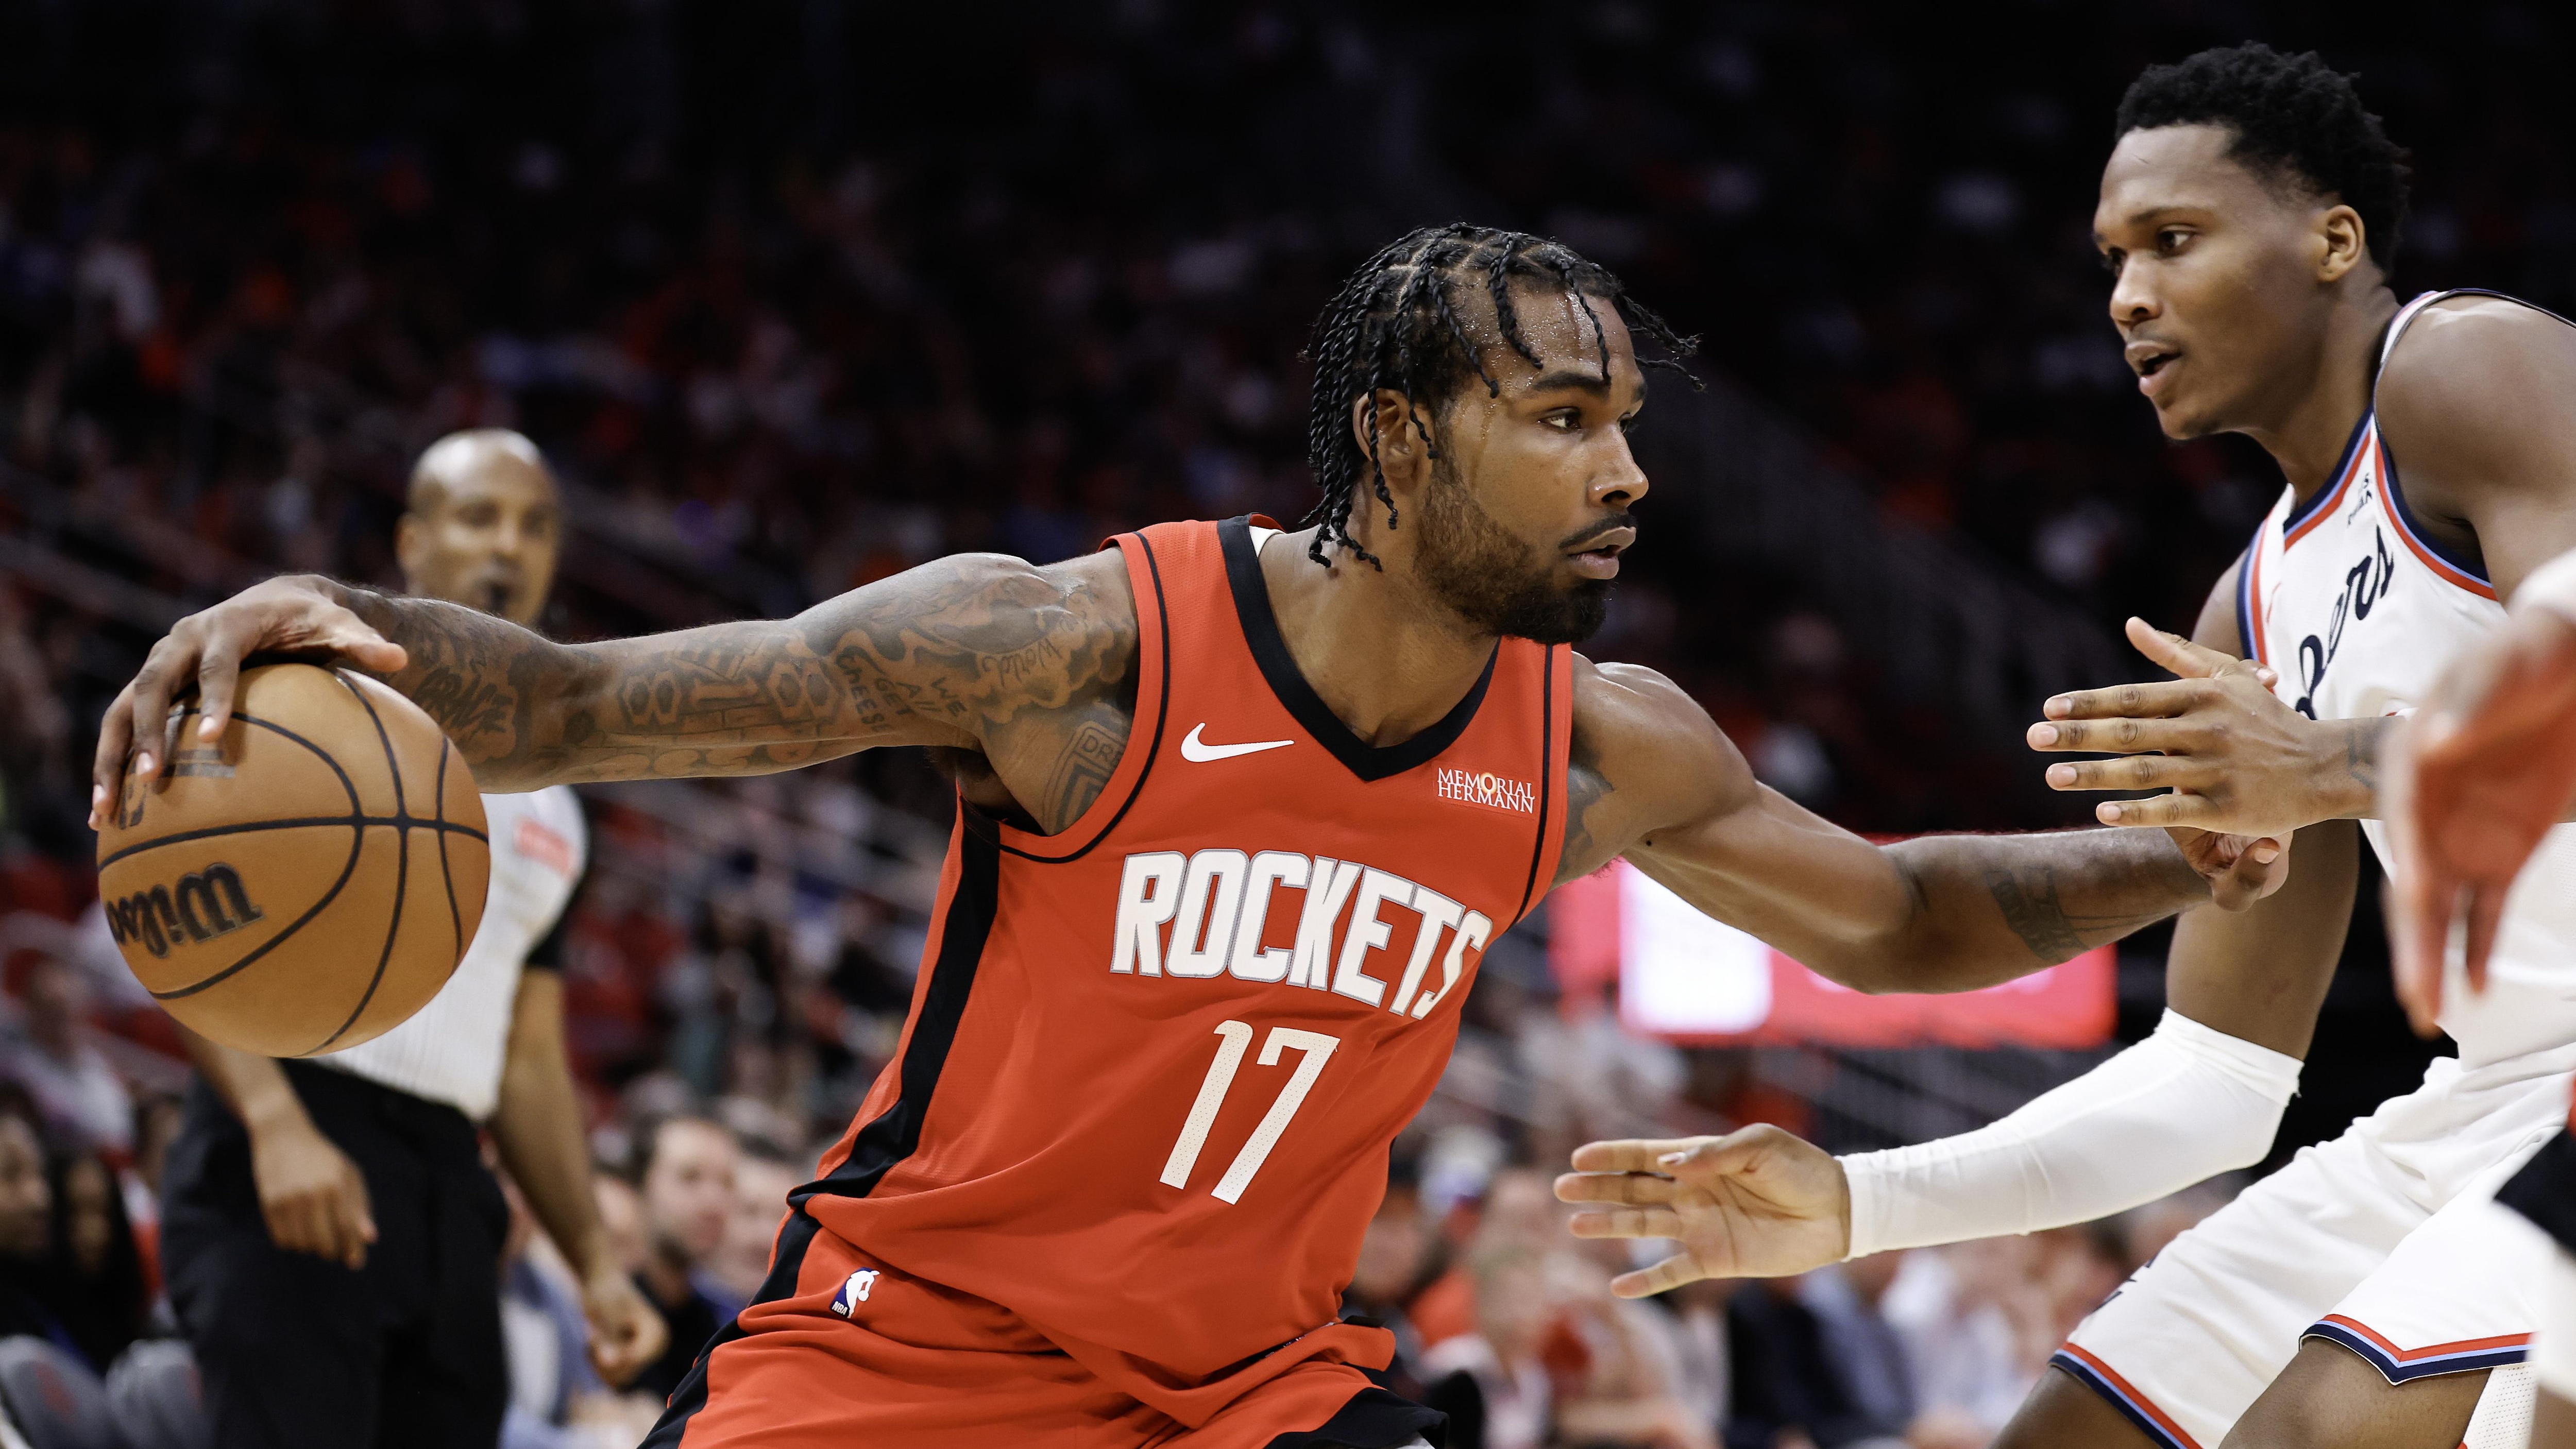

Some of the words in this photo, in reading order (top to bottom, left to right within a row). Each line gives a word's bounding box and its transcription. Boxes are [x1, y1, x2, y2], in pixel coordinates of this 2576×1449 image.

[2295, 524, 2394, 720] pers
[1437, 768, 1535, 799] MEMORIAL
[1437, 781, 1535, 813] HERMANN
[106, 862, 264, 959] Wilso
[1109, 849, 1493, 1020] ROCKETS
[1159, 1020, 1341, 1205] 17
[832, 1301, 848, 1315] NBA
